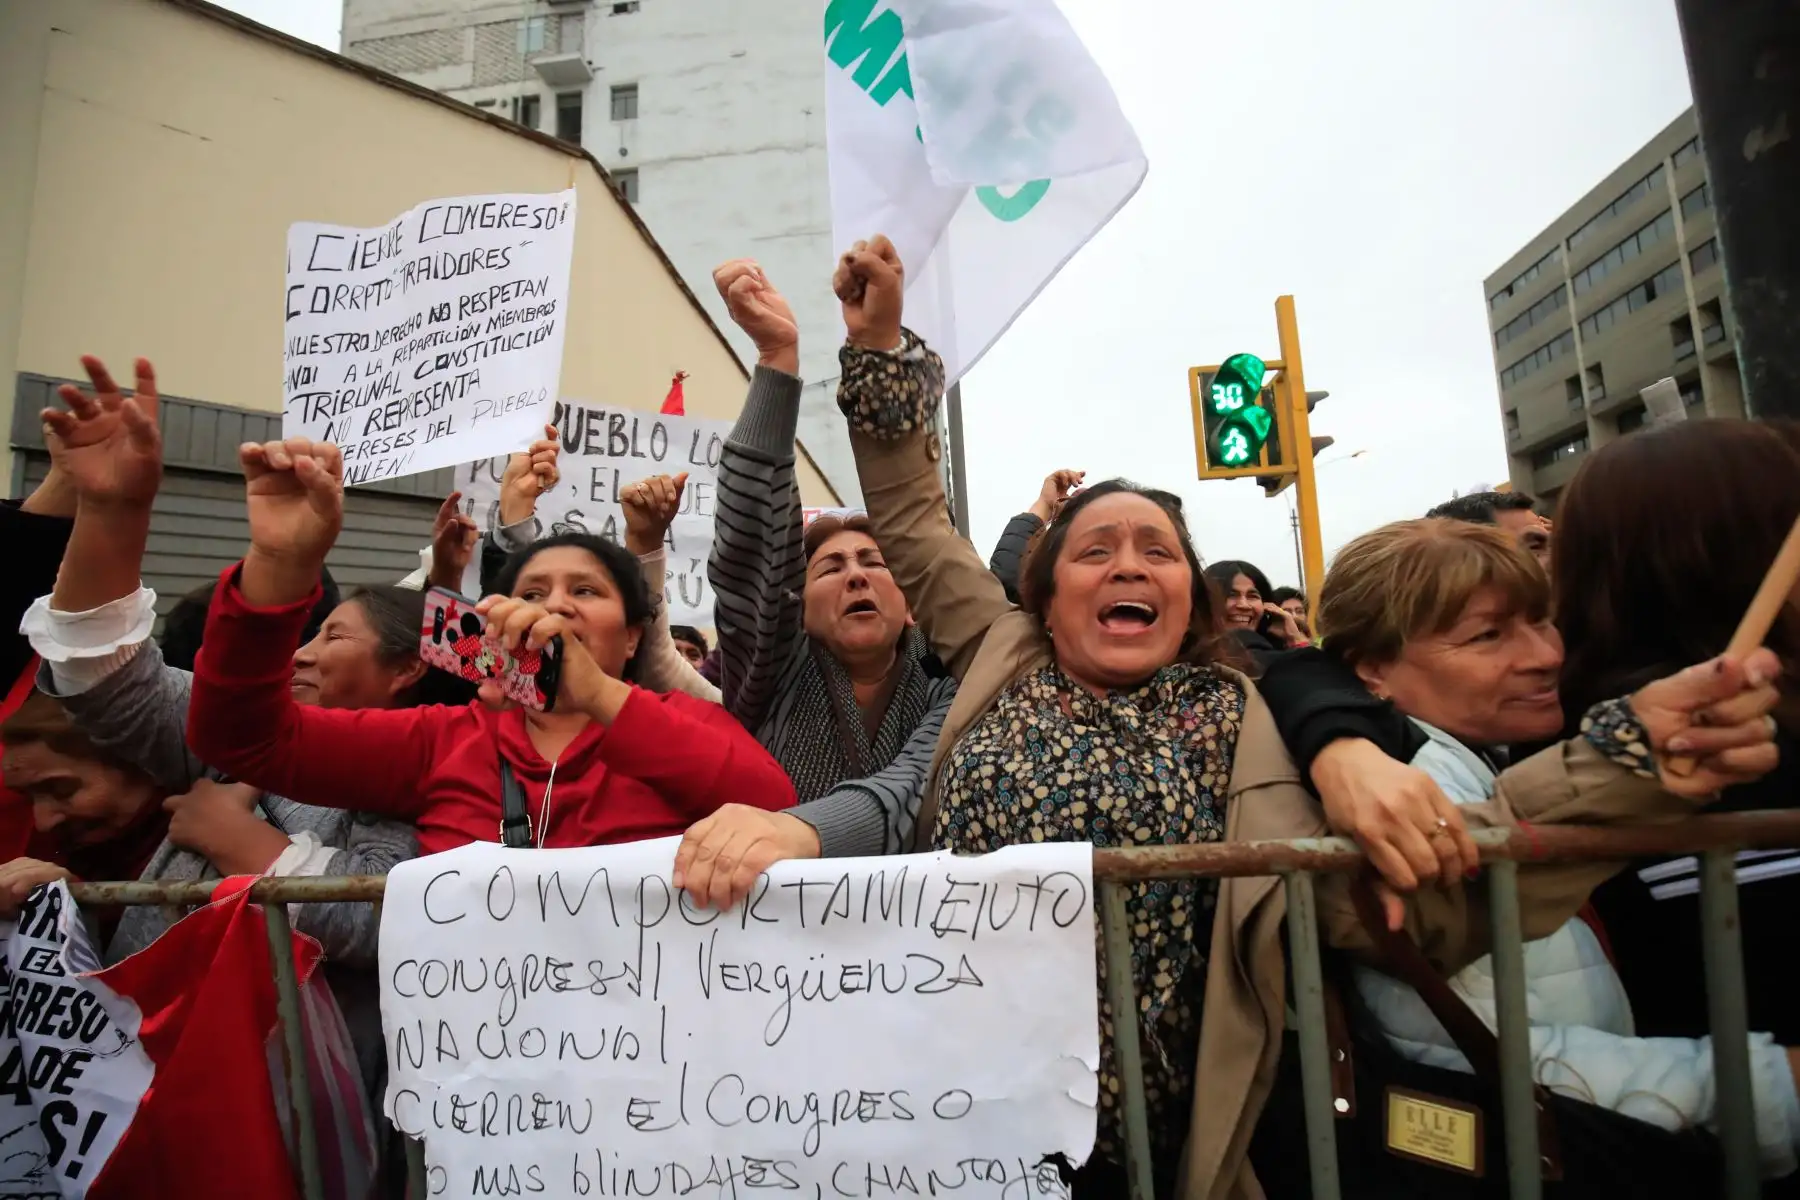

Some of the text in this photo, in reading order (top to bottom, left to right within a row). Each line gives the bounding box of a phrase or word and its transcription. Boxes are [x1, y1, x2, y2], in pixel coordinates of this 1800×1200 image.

[428, 302, 452, 325] NO
[459, 275, 549, 321] RESPETAN
[342, 363, 357, 383] A
[365, 357, 382, 377] LA
[323, 368, 481, 443] NO REPRESENTA
[1211, 382, 1244, 411] 30
[421, 414, 457, 445] DEL
[471, 387, 548, 429] PUEBLO
[1405, 1105, 1458, 1135] ELLE
[472, 1164, 546, 1196] MAS
